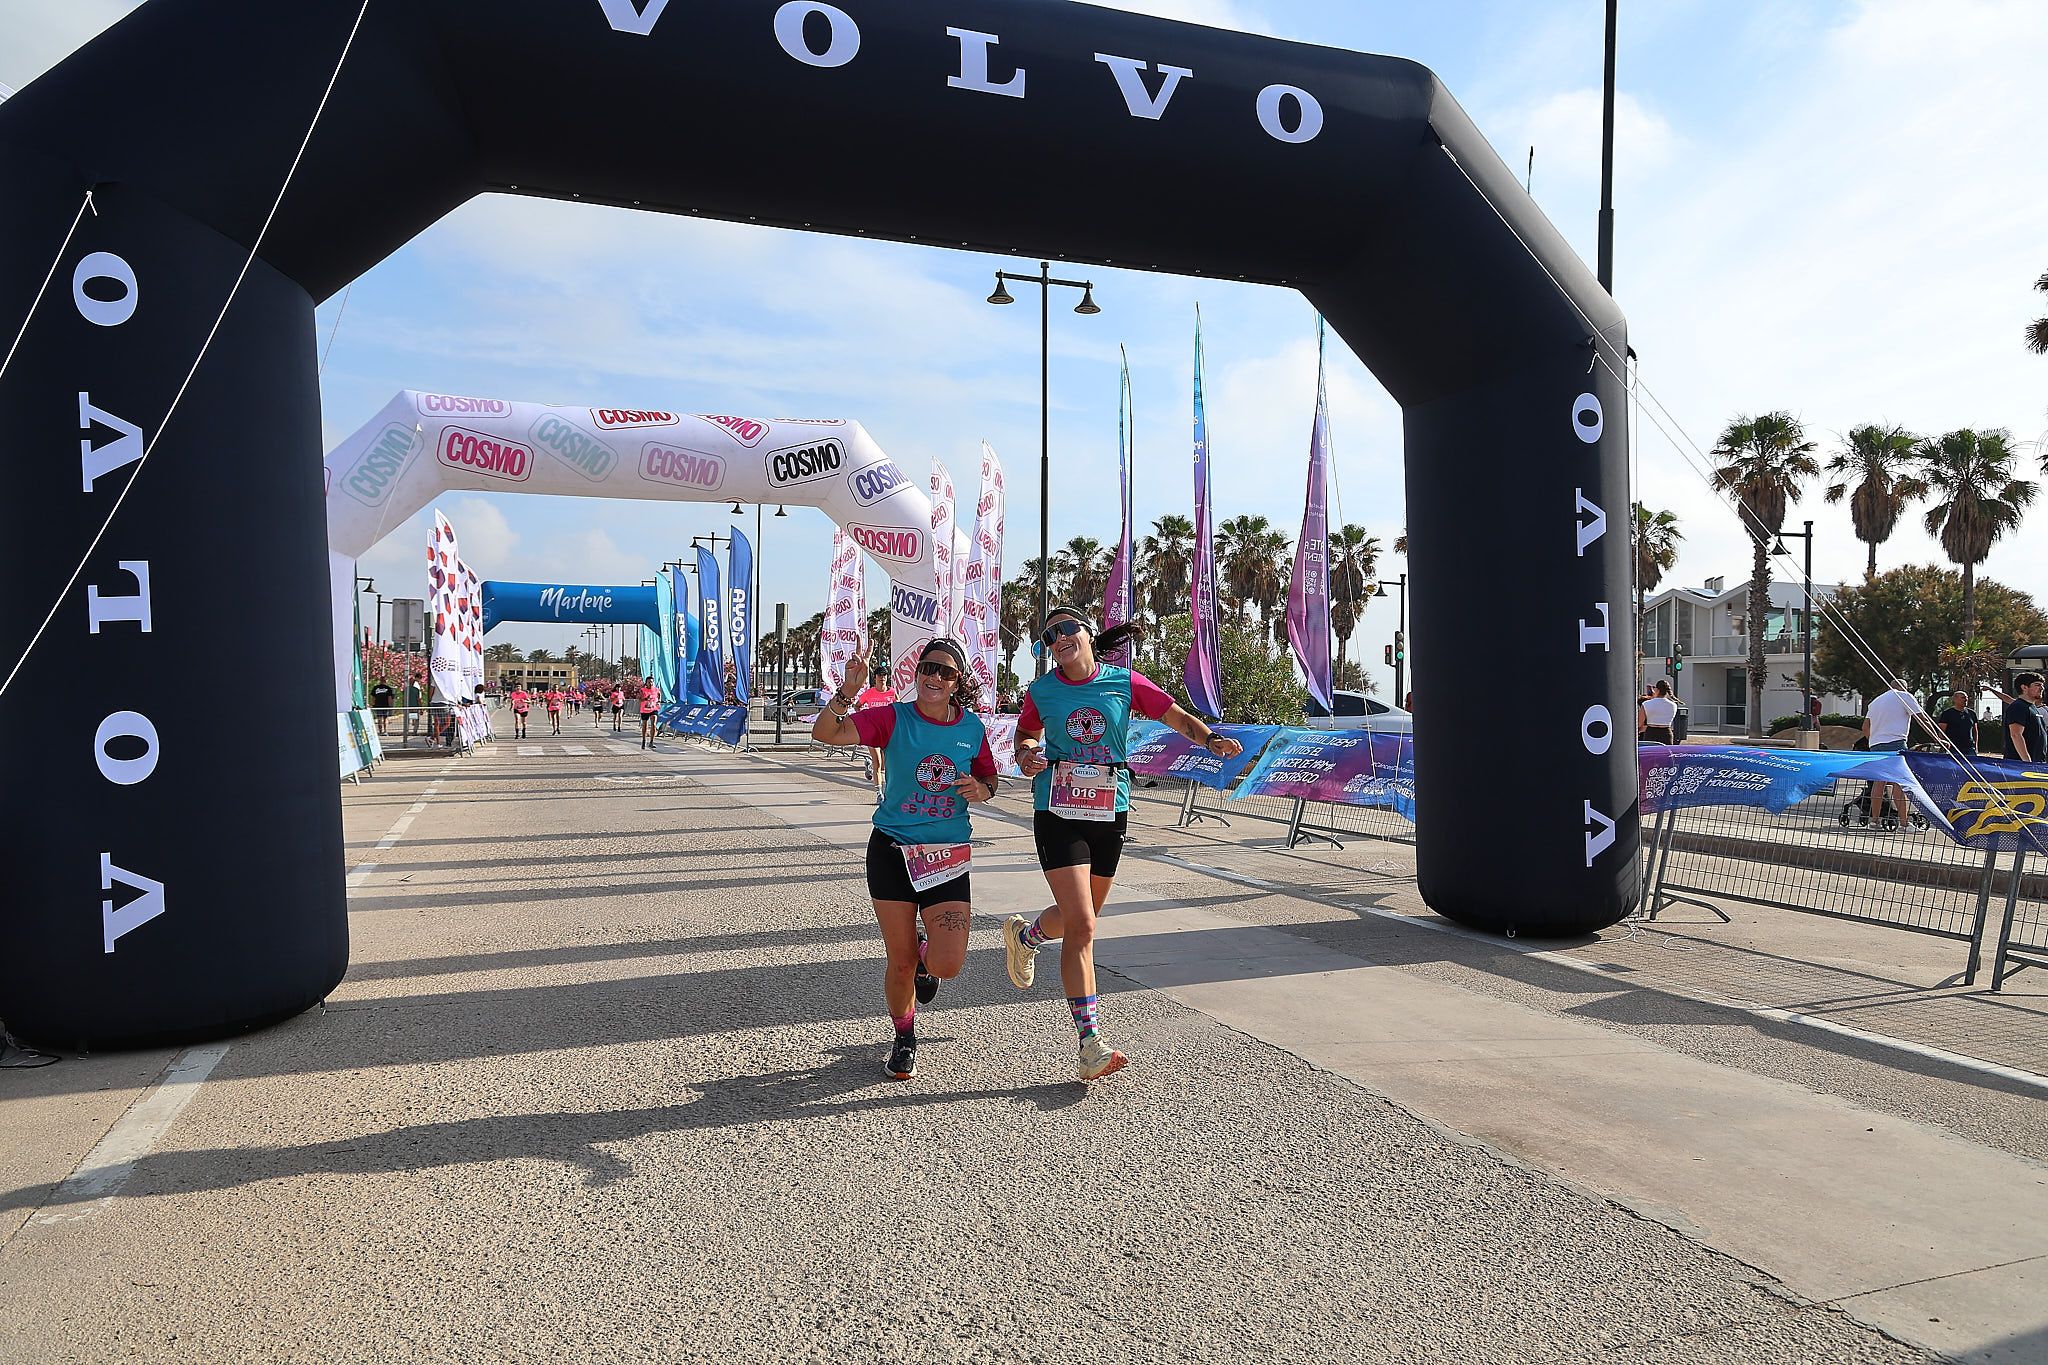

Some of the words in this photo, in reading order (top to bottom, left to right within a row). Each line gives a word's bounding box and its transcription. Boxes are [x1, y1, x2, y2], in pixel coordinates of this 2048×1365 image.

[349, 428, 415, 499] COSMO
[446, 432, 526, 476] COSMO
[537, 418, 611, 475] COSMO
[773, 442, 841, 482] COSMO
[647, 447, 719, 486] COSMO
[853, 527, 918, 558] COSMO
[73, 251, 165, 953] VOLVO
[539, 588, 612, 618] Marlene
[1571, 392, 1616, 868] VOLVO
[1072, 788, 1097, 799] 016
[1705, 778, 1766, 791] MOVIMIENTO
[927, 848, 951, 863] 016
